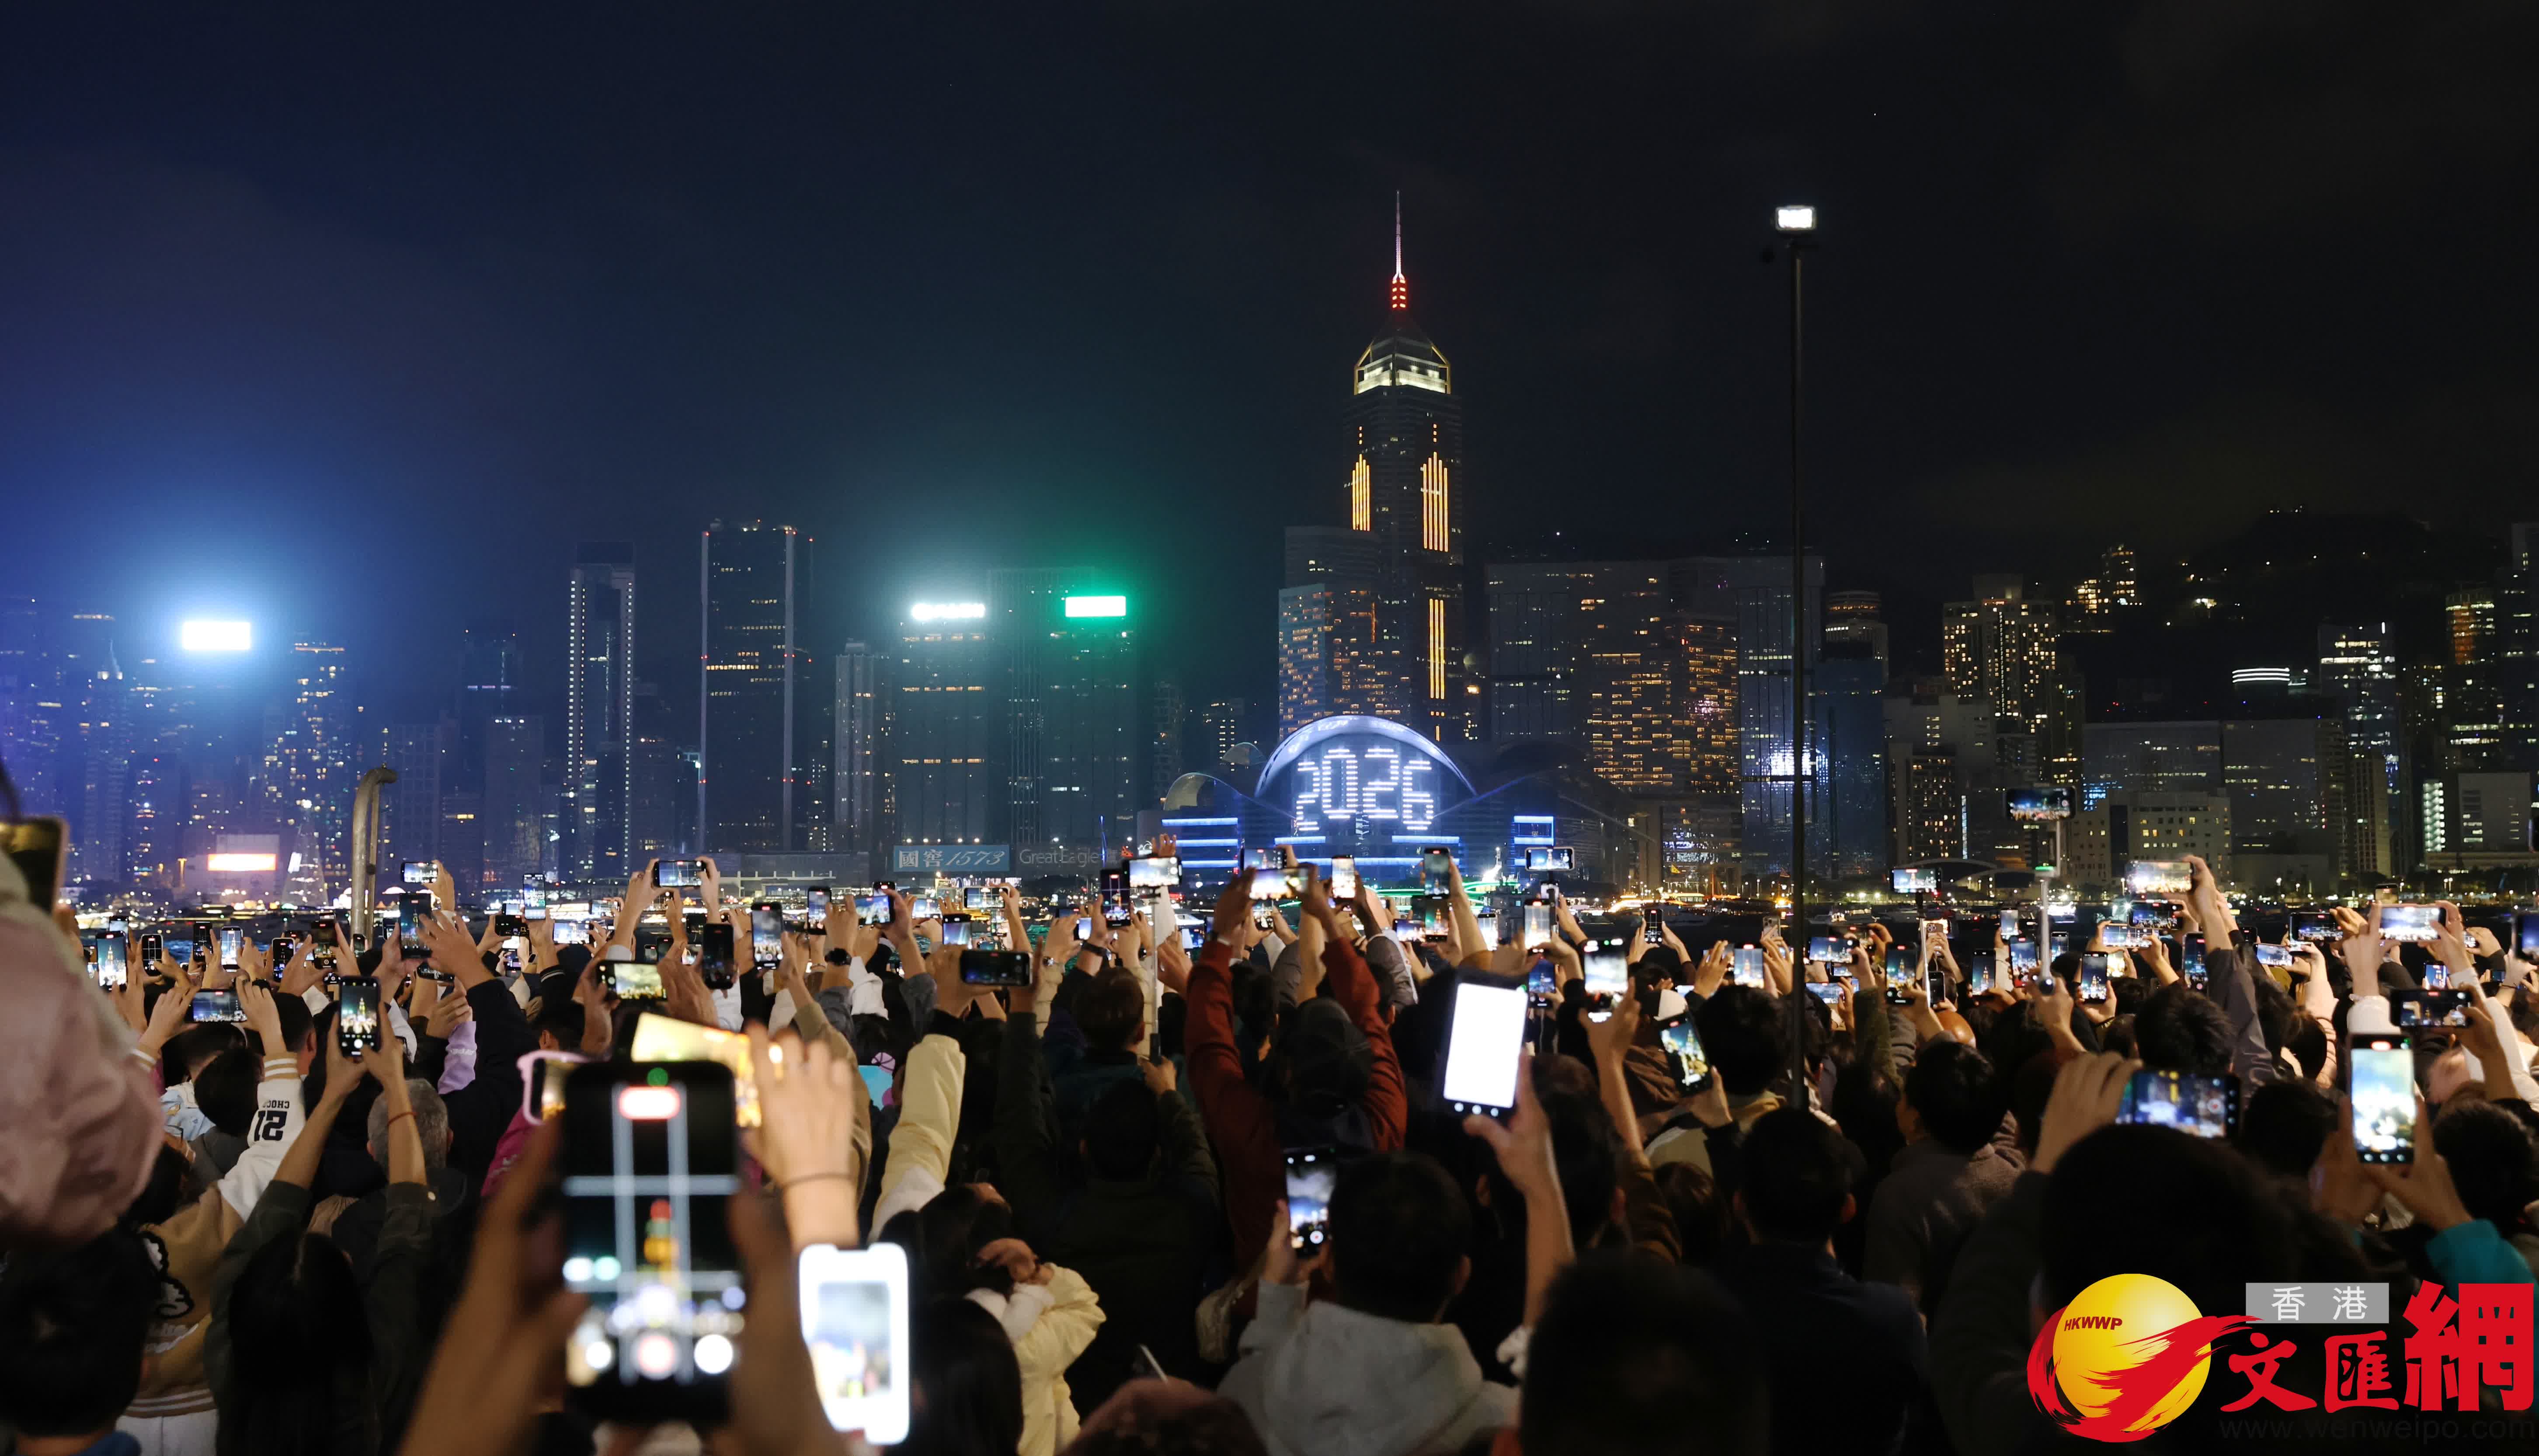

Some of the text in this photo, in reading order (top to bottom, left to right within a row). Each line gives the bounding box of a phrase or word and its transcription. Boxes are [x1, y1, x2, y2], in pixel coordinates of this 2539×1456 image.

[1295, 748, 1434, 831] 2026
[1019, 849, 1056, 864] Great
[1061, 848, 1098, 867] Eagle
[263, 1100, 289, 1109] CHOC
[254, 1110, 287, 1141] 21
